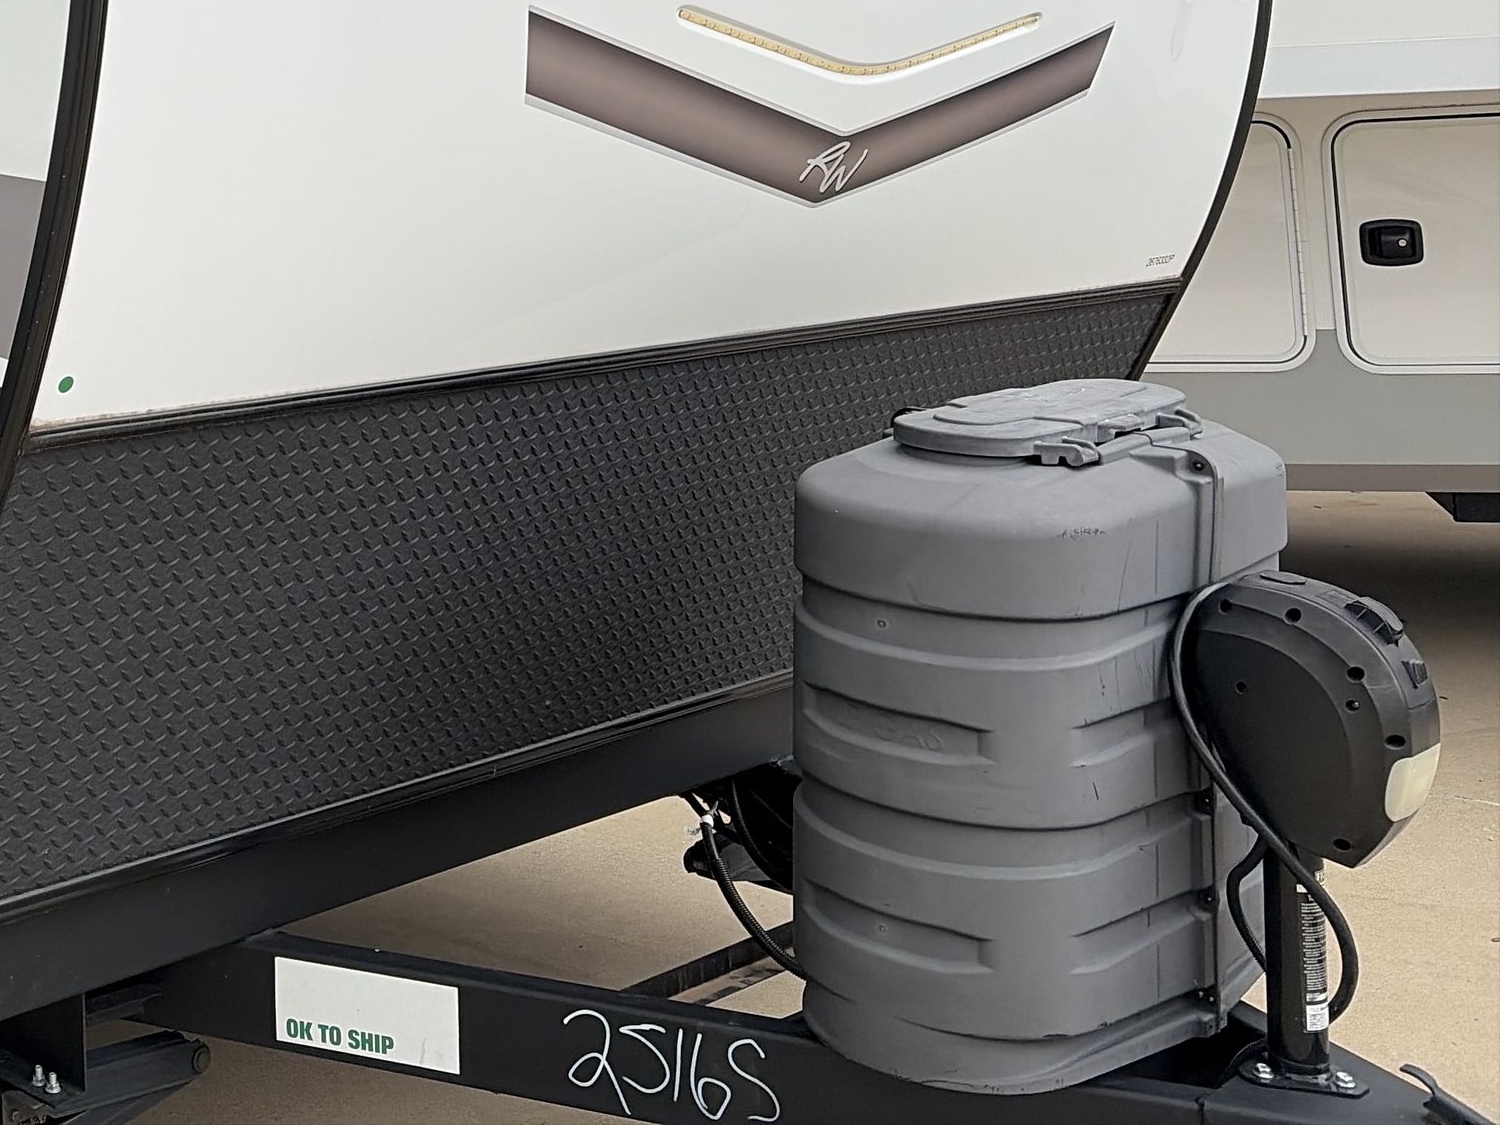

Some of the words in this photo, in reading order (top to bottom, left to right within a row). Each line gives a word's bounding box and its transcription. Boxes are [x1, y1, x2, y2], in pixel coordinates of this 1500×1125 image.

[286, 1018, 313, 1041] OK
[318, 1024, 342, 1046] TO
[348, 1029, 394, 1054] SHIP
